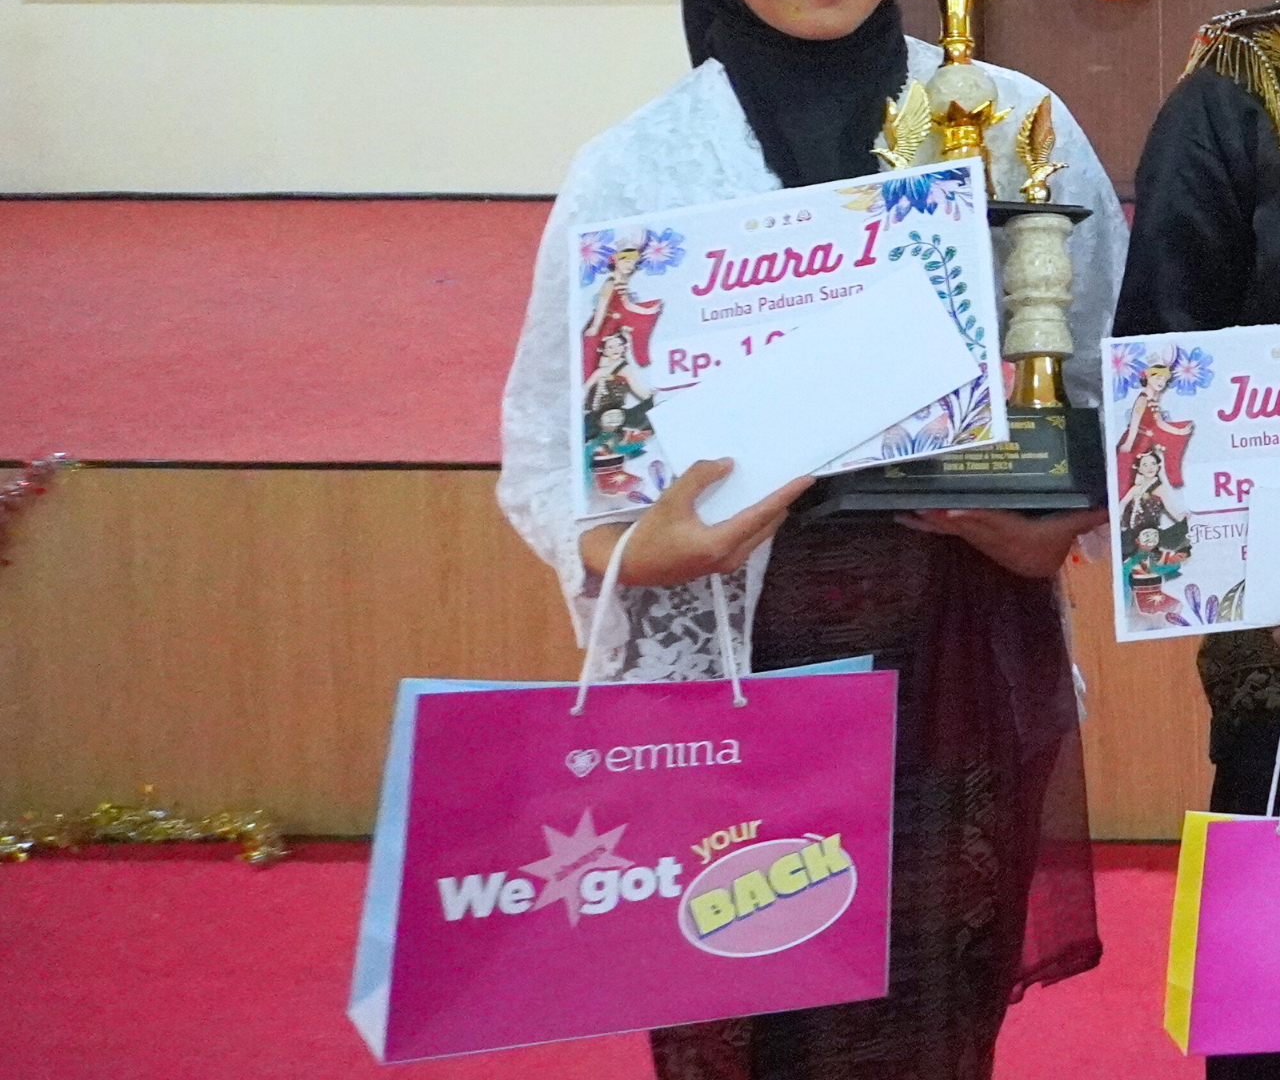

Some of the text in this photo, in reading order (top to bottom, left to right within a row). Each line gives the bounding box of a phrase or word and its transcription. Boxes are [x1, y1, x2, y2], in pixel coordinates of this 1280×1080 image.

[691, 220, 882, 296] Juara 1
[701, 302, 752, 322] Lomba
[758, 292, 814, 312] Paduan
[668, 348, 721, 378] Rp.
[1231, 432, 1280, 448] Lomba
[1187, 523, 1248, 545] FESTIV
[605, 738, 742, 772] emina
[691, 819, 762, 864] your
[437, 871, 535, 921] We
[579, 857, 684, 915] got
[689, 833, 850, 940] BACK
